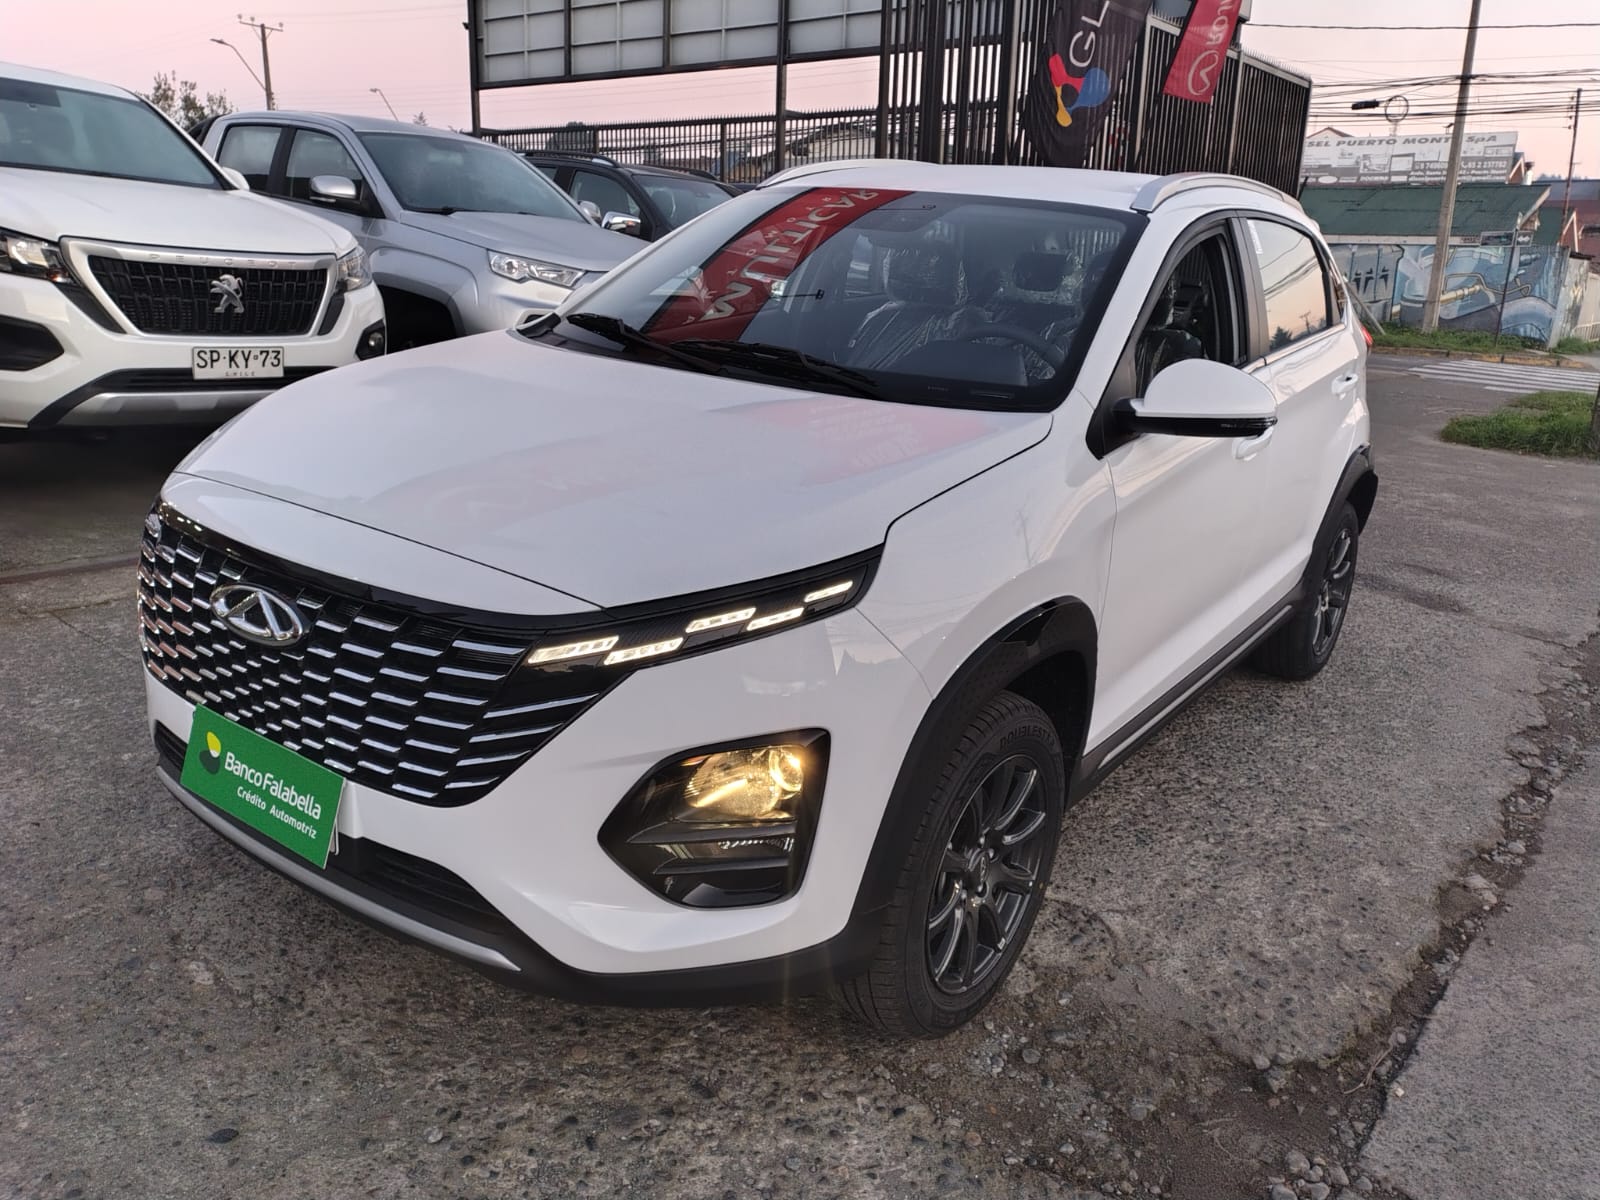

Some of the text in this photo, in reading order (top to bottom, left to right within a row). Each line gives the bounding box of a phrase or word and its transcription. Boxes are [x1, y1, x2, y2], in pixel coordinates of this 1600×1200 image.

[1305, 134, 1498, 148] SEL PUERTO MONT SpA
[150, 253, 297, 269] PEUGEOT
[236, 785, 317, 839] Crédito Automotriz
